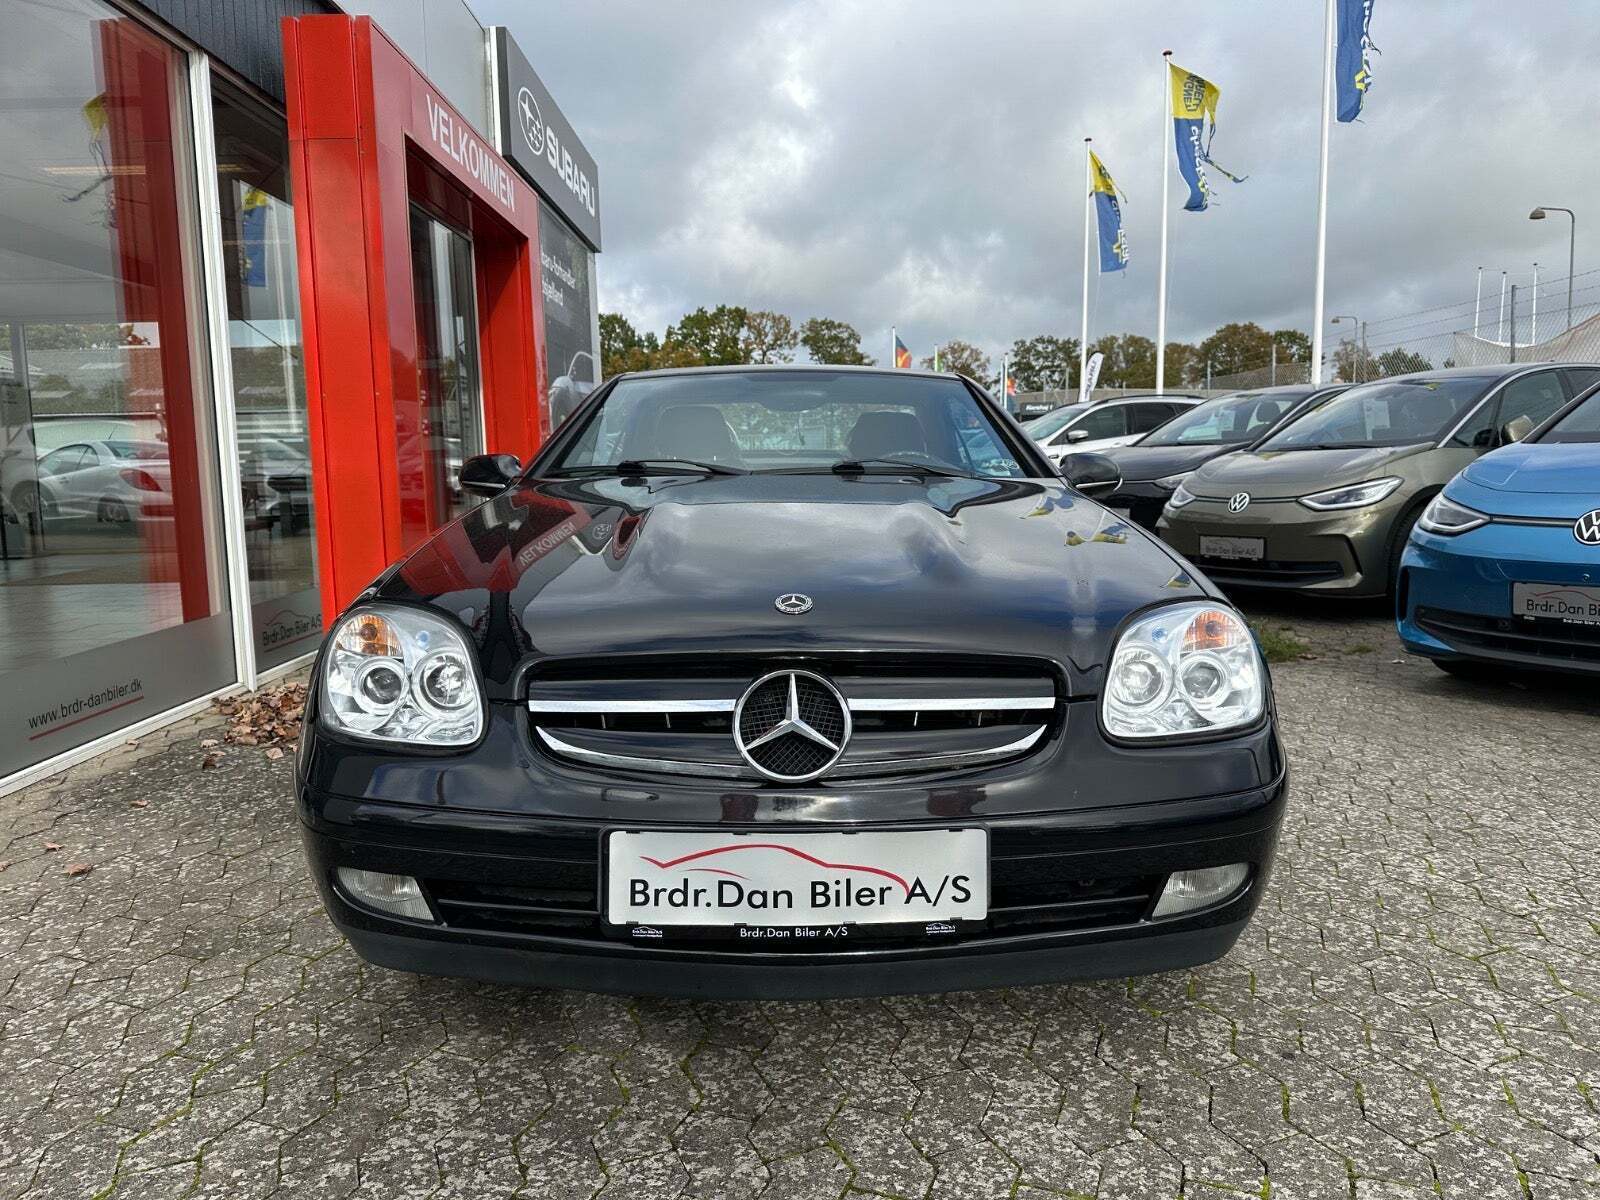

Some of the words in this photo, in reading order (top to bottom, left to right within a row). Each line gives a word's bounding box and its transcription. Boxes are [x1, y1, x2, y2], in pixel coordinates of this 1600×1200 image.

[426, 93, 515, 212] VELKOMMEN
[546, 125, 596, 217] SUBARU
[1526, 599, 1584, 615] Brdr.Dan
[28, 679, 143, 729] www.brdr-danbiler.dk
[630, 878, 793, 909] Brdr.Dan
[810, 878, 892, 908] Biler
[904, 875, 971, 907] A/S
[740, 928, 790, 938] Brdr.Dan
[795, 927, 820, 938] Biler
[825, 926, 848, 938] A/S
